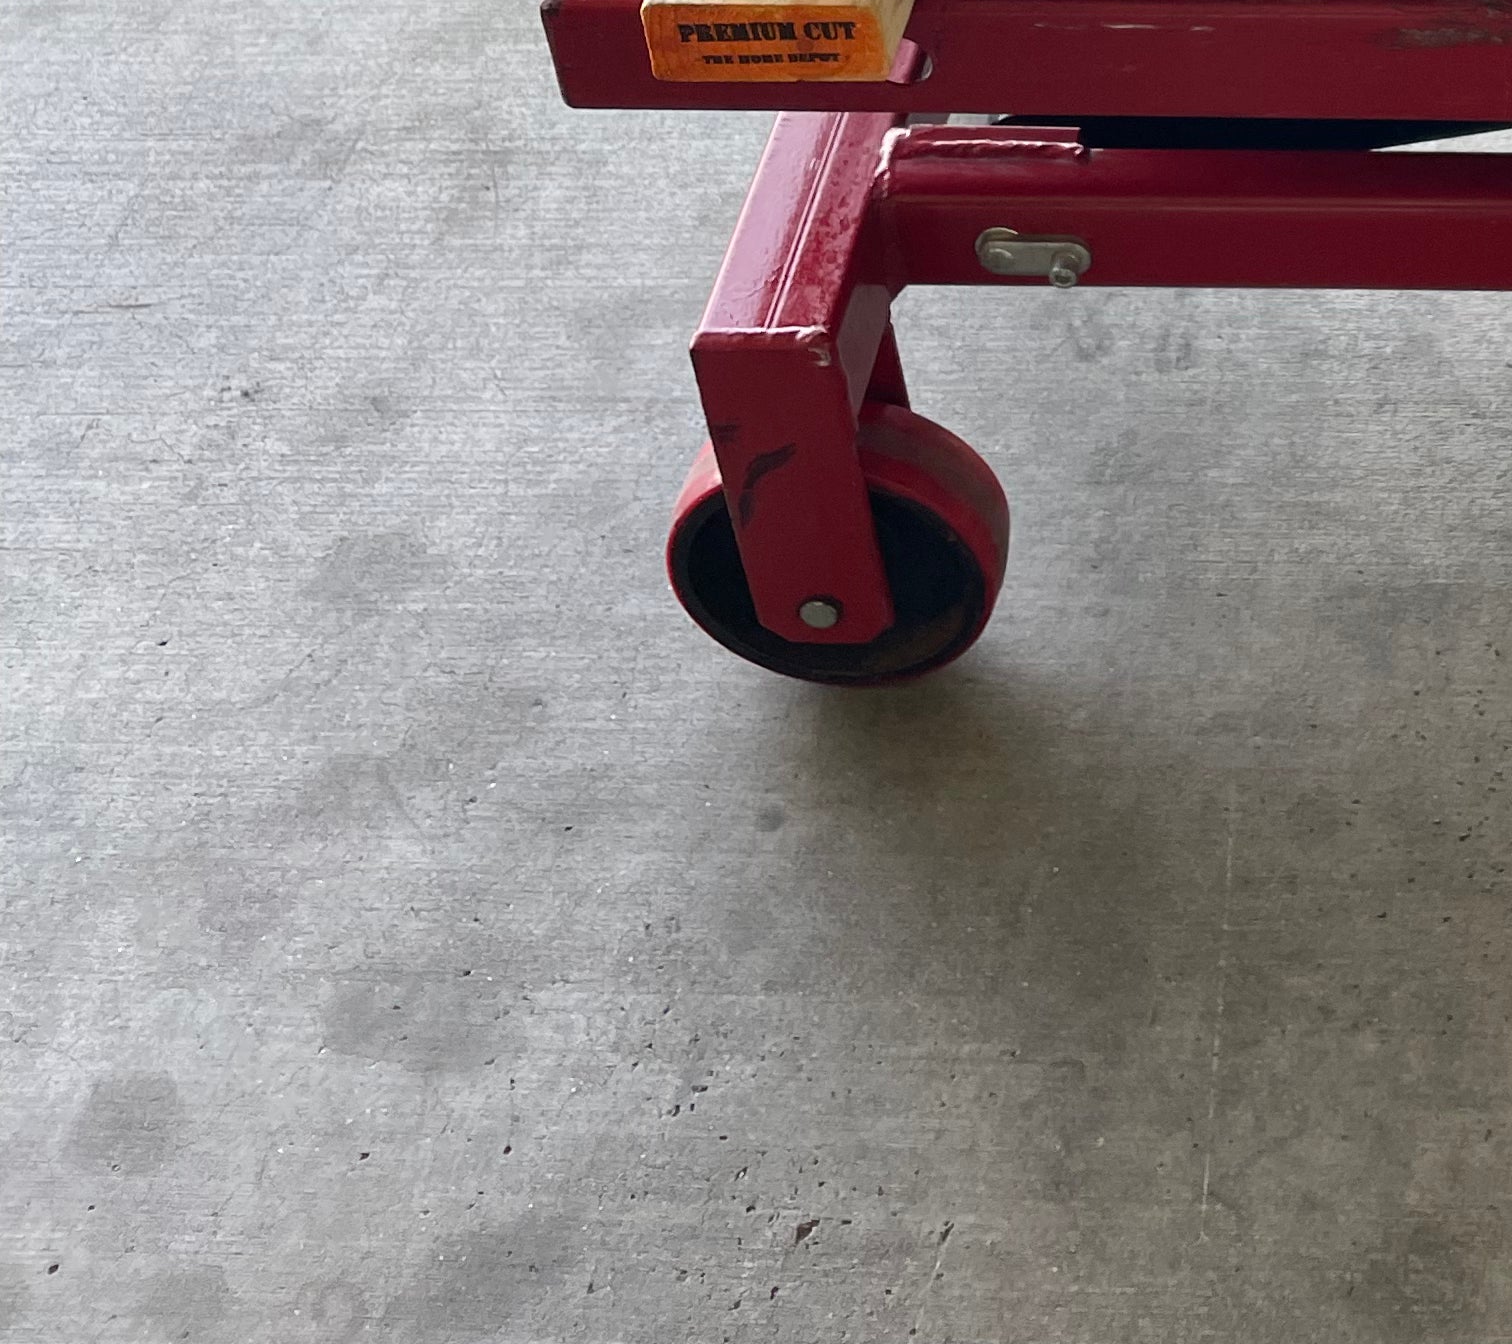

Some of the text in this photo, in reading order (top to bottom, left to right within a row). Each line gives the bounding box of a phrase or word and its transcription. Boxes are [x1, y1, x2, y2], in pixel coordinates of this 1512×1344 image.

[677, 21, 857, 43] PREMIUM CUT
[702, 53, 841, 65] THE HOME DEPOT
